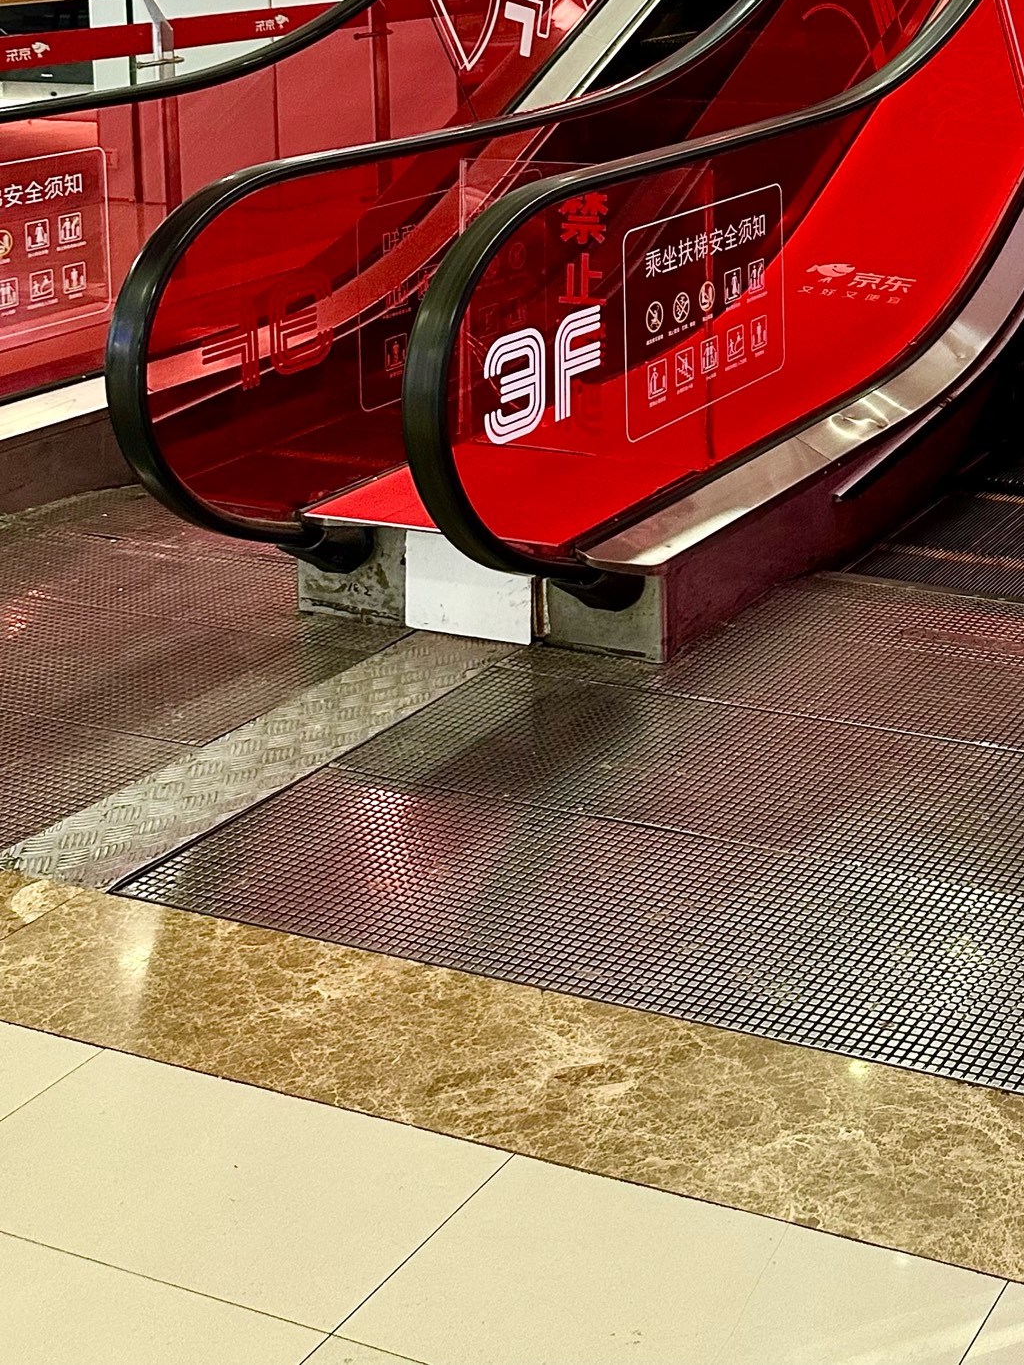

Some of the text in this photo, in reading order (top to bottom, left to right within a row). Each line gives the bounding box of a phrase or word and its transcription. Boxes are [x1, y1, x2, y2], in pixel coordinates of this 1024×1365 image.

[645, 214, 767, 278] 乘坐扶梯安全须知
[847, 272, 917, 294] 京东
[483, 304, 601, 445] 3F
